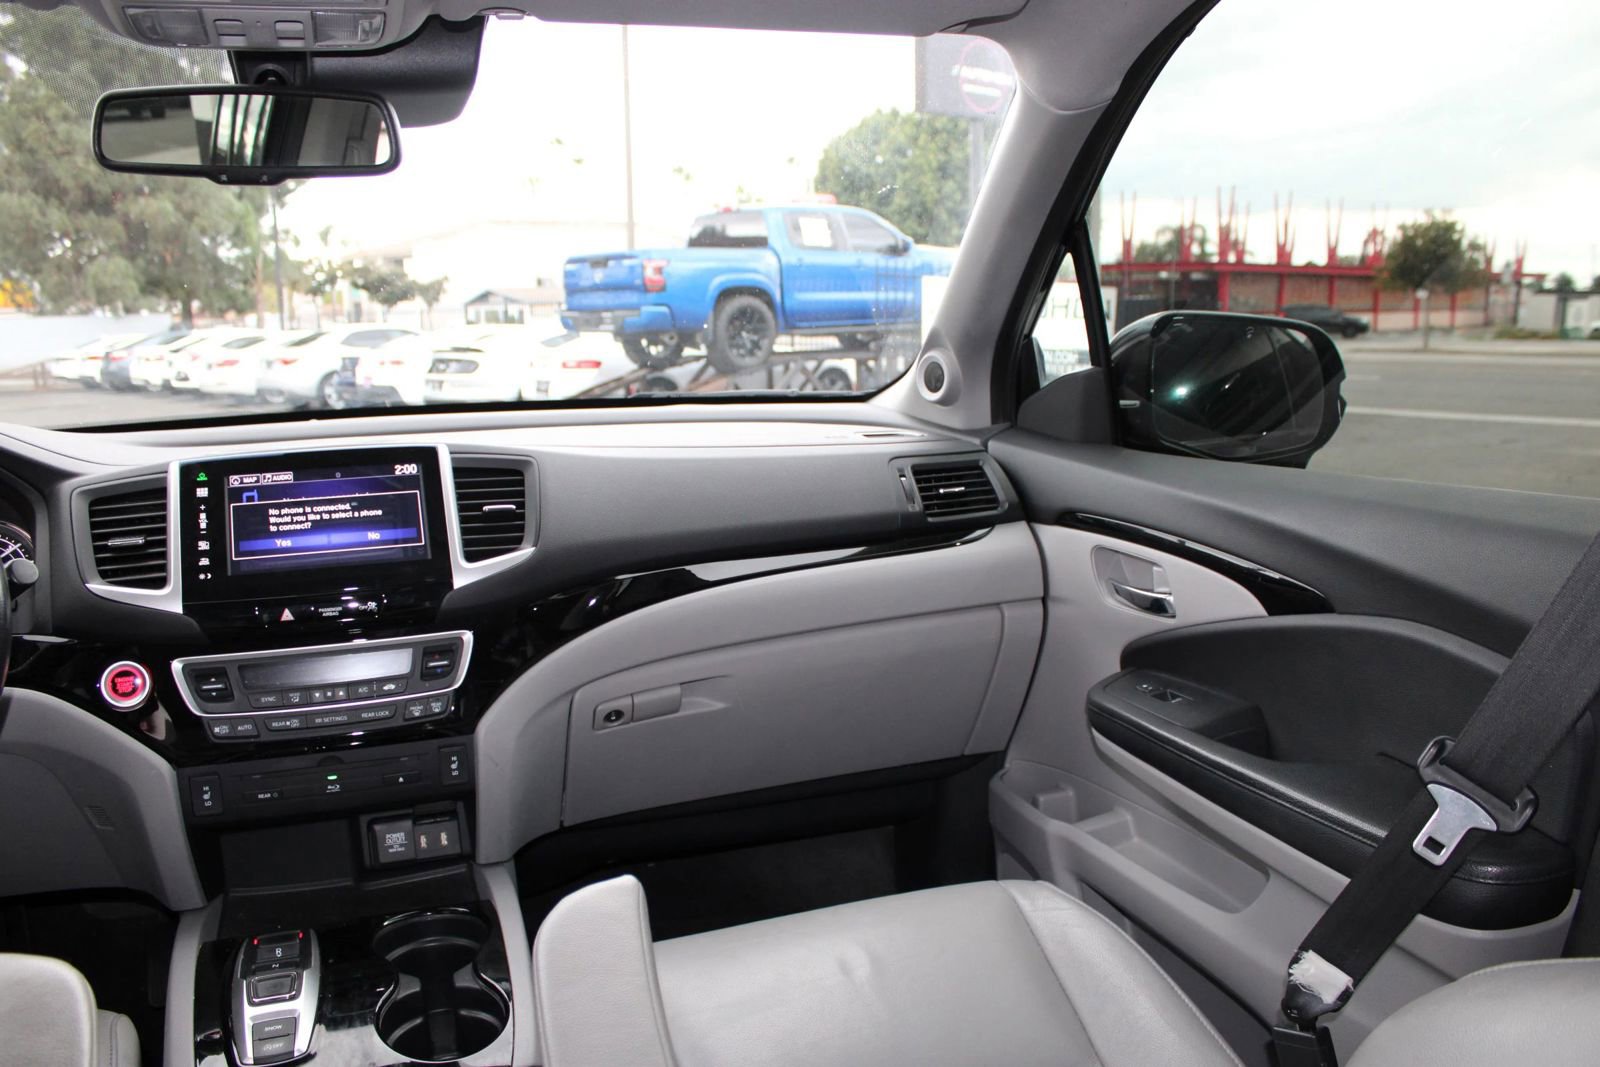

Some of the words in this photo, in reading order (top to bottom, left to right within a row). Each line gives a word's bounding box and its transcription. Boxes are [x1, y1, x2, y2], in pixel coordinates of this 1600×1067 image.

[394, 464, 417, 475] 2:00
[281, 507, 303, 517] phone
[313, 503, 351, 512] connected.
[270, 516, 291, 524] Would
[360, 509, 382, 518] phone
[279, 522, 312, 531] connect?
[368, 532, 380, 540] No
[275, 539, 292, 547] Yes
[264, 1024, 283, 1032] SNOW
